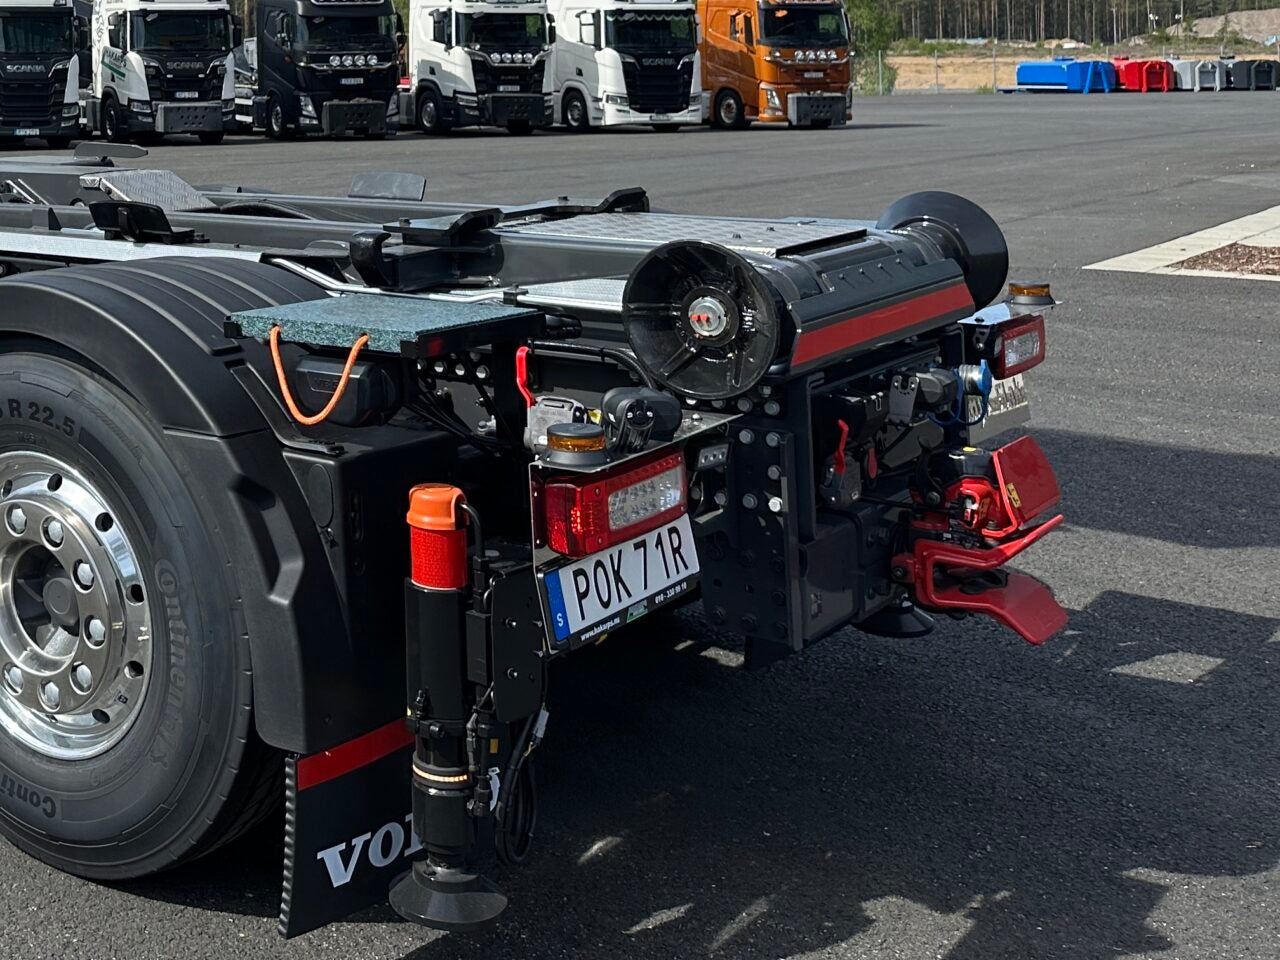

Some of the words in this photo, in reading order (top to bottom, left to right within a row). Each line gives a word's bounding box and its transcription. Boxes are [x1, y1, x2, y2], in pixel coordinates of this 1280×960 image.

[6, 65, 46, 73] SCANIA
[7, 398, 23, 419] R
[28, 401, 76, 437] 22.5
[572, 549, 632, 621] POK
[633, 526, 689, 591] 71R
[556, 612, 564, 627] S
[0, 774, 57, 819] Conti
